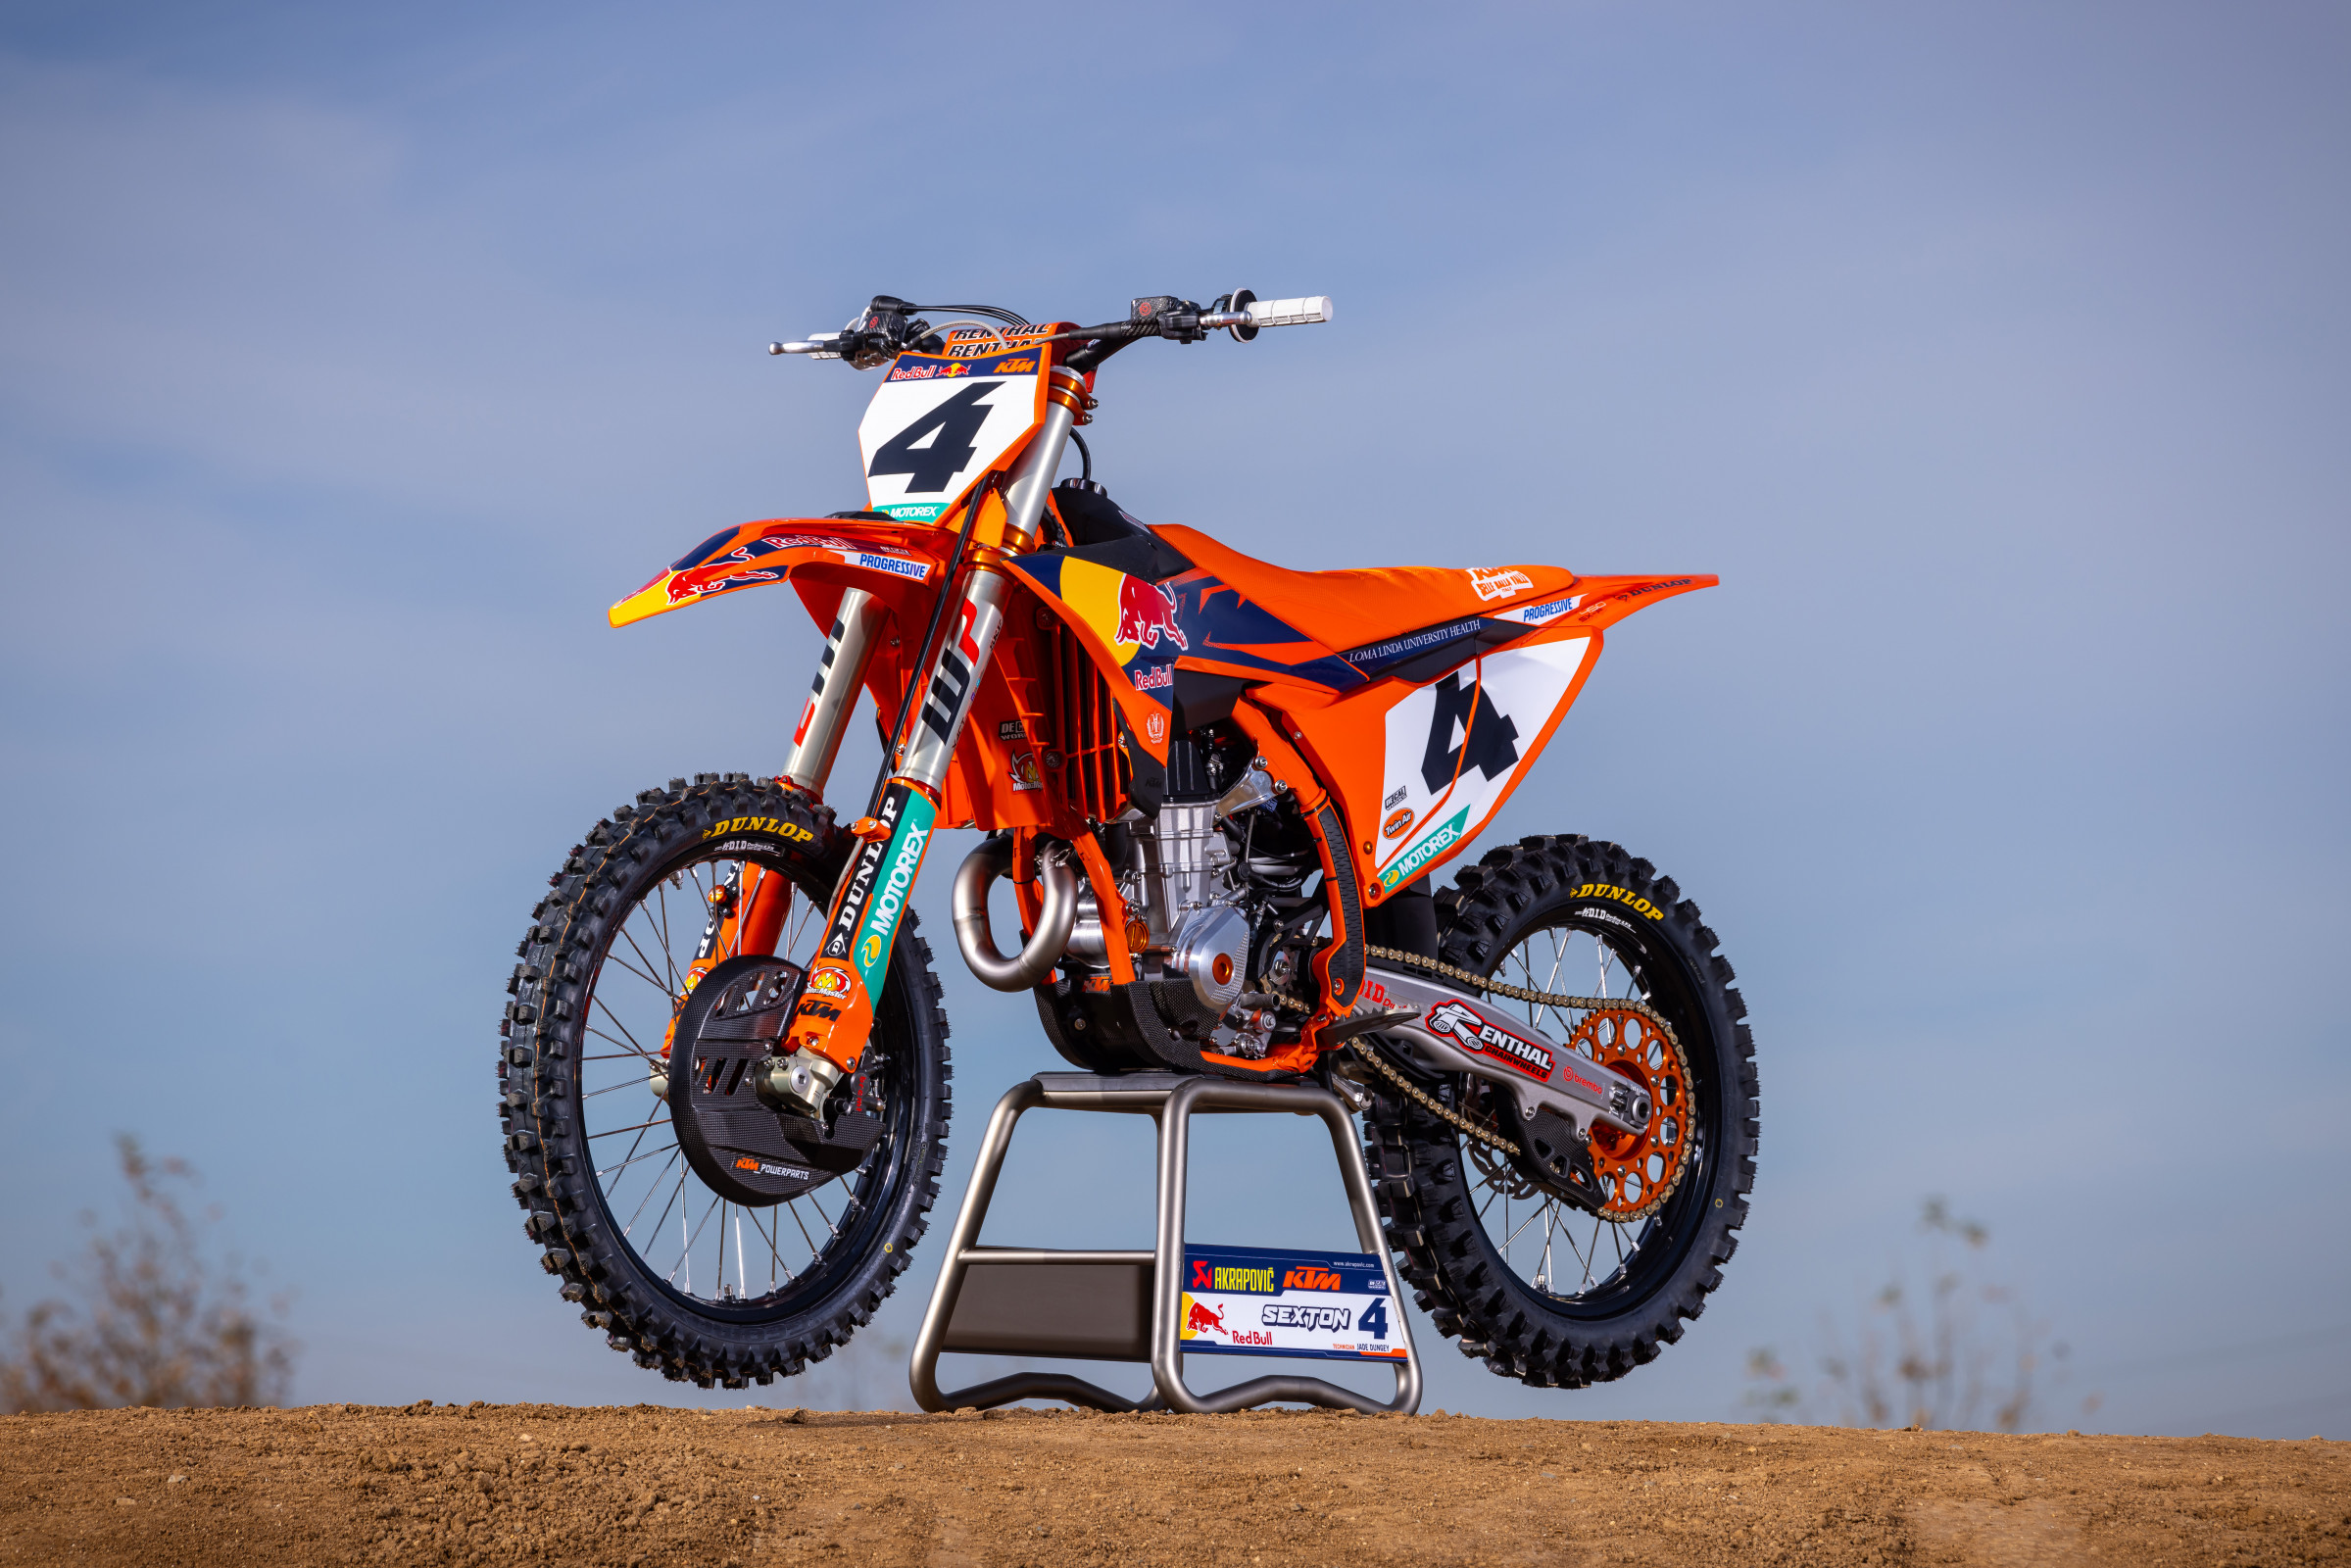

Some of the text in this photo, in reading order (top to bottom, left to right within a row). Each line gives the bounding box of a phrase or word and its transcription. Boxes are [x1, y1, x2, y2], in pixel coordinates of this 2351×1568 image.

[891, 365, 937, 380] Red Bull
[993, 358, 1036, 373] KTM
[867, 381, 1006, 494] 4
[890, 506, 938, 517] MOTOREX
[859, 554, 926, 578] PROGRESSIVE
[1629, 578, 1691, 596] DUNLOP
[1523, 598, 1573, 622] PROGRESSIVE
[1349, 619, 1481, 662] LOMA LINDA UNIVERSITY HEALTH
[1134, 663, 1173, 691] Red Bull
[1421, 670, 1519, 796] 4
[710, 816, 814, 842] DUNLOP
[1385, 811, 1413, 837] Twin Air
[1397, 823, 1461, 876] MOTOREX
[838, 796, 897, 931] DUNLP
[869, 822, 928, 936] MOTOREX
[1576, 883, 1664, 920] DUNLOP
[795, 1000, 842, 1022] KTM
[1484, 1045, 1548, 1079] CHAINWHEELS
[1574, 1073, 1603, 1095] brembo
[735, 1157, 809, 1180] KTM POWERPARTS
[1282, 1266, 1341, 1291] KTM
[1261, 1298, 1389, 1340] SEXTON 4
[1232, 1330, 1273, 1346] Red Bull
[1356, 1343, 1369, 1351] JADE
